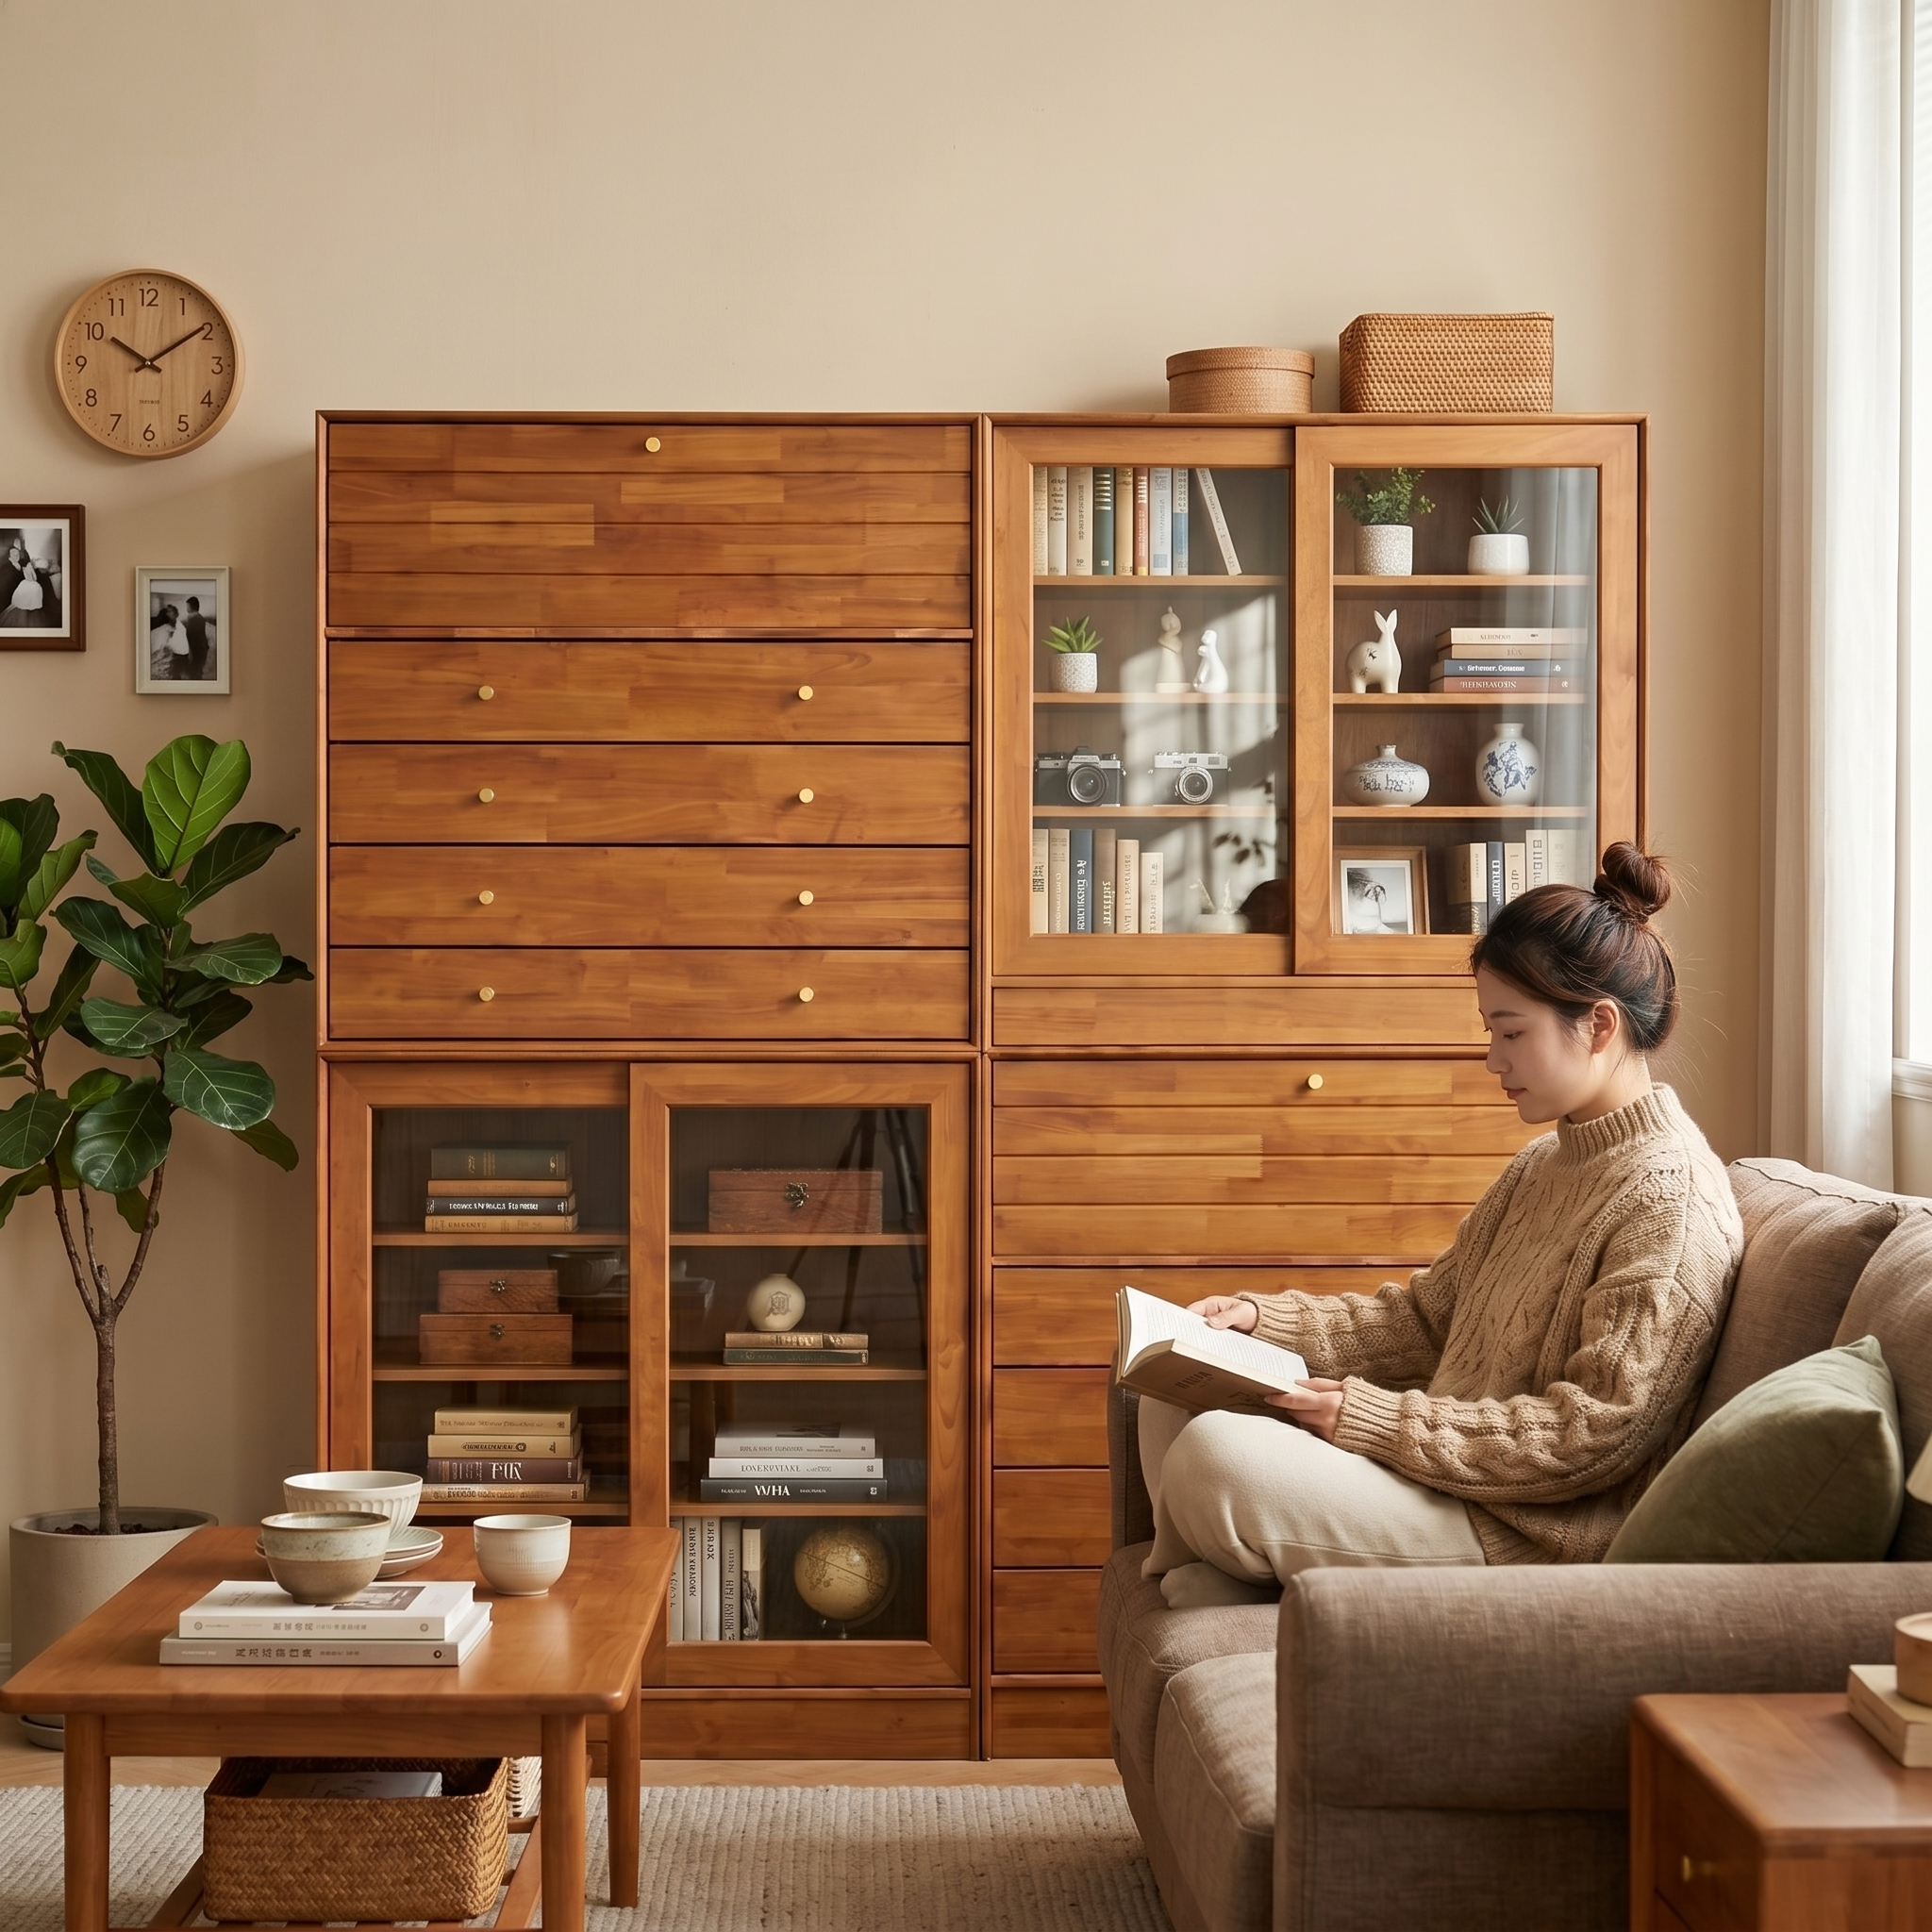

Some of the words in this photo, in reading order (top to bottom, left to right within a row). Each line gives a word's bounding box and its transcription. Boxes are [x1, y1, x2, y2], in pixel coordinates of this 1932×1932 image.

[108, 298, 125, 316] 11
[139, 288, 159, 307] 12
[179, 297, 186, 316] 1
[85, 322, 105, 341] 10
[201, 322, 213, 341] 2
[75, 355, 88, 374] 9
[211, 356, 224, 375] 3
[85, 388, 98, 407] 8
[200, 389, 213, 408] 4
[109, 413, 123, 432] 7
[142, 423, 156, 441] 6
[176, 414, 190, 432] 5
